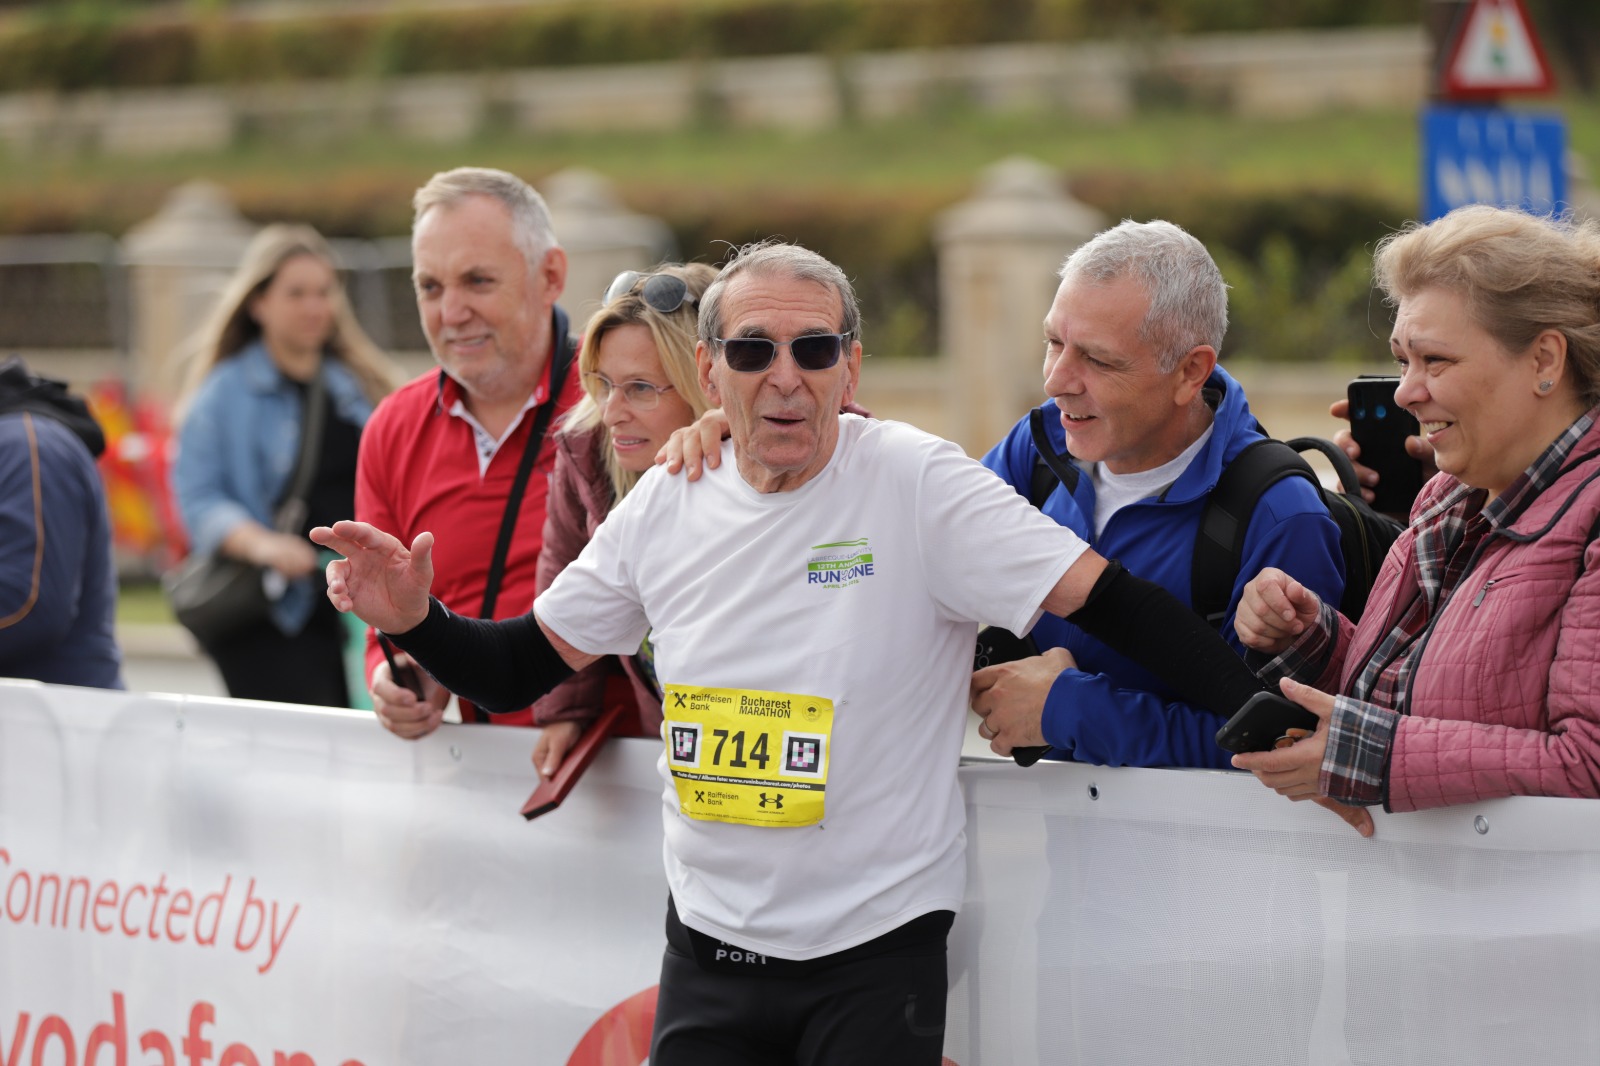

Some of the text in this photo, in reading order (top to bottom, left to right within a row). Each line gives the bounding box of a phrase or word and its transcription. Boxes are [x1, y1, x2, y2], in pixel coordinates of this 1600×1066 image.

[808, 570, 841, 584] RUN
[847, 563, 874, 580] ONE
[690, 692, 791, 710] Raiffeisen Bucharest
[690, 702, 710, 711] Bank
[739, 705, 791, 719] MARATHON
[712, 728, 770, 770] 714
[707, 791, 739, 801] Raiffeisen
[707, 798, 723, 806] Bank
[233, 877, 302, 975] by
